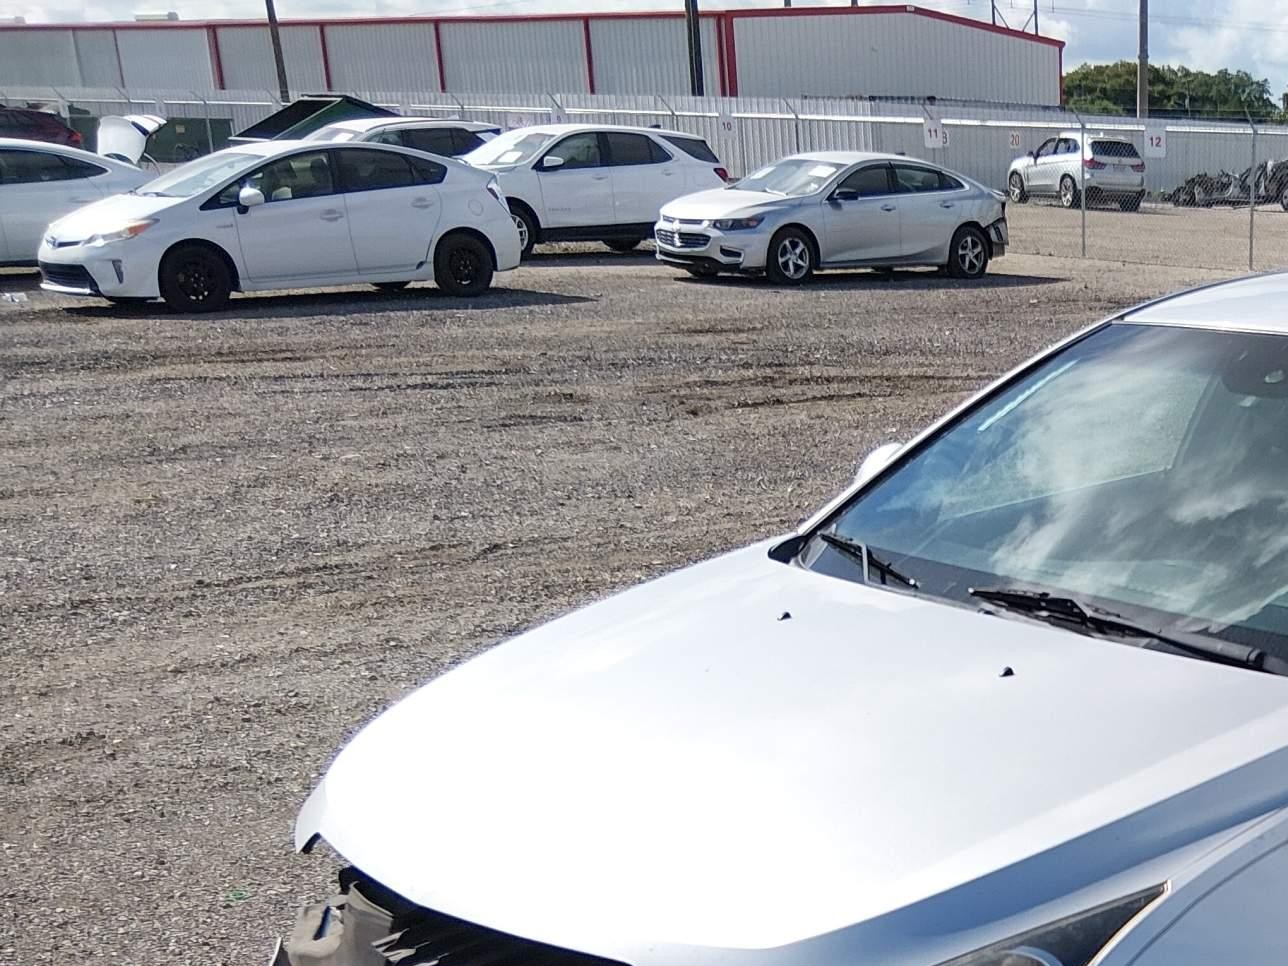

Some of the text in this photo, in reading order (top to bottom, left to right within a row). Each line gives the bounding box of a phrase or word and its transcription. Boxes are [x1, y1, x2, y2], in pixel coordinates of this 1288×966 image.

[722, 121, 732, 131] 10
[927, 128, 938, 139] 11
[1010, 133, 1020, 146] 20
[1149, 136, 1162, 148] 12
